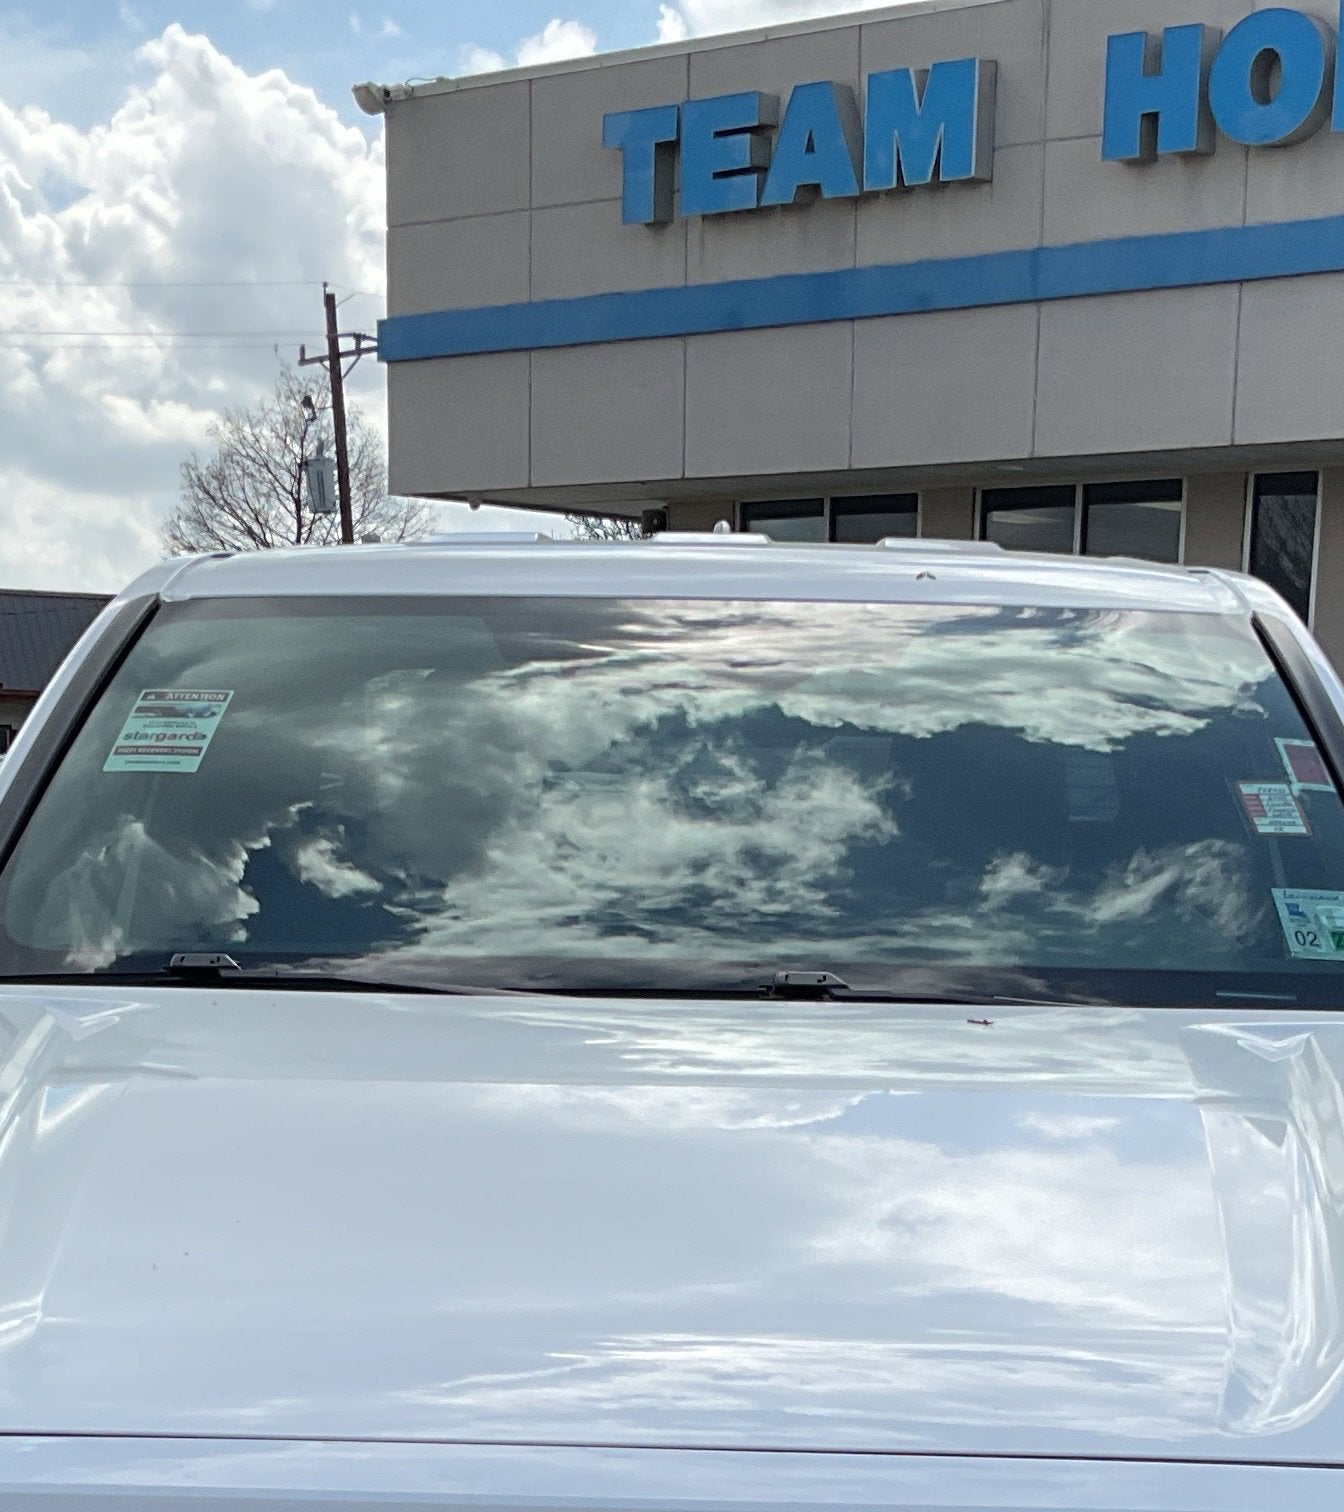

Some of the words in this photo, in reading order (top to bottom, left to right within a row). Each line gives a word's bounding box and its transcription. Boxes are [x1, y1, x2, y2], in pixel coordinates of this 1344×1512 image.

[602, 57, 986, 225] TEAM
[166, 692, 226, 701] ATTENTION
[1294, 930, 1320, 947] 02
